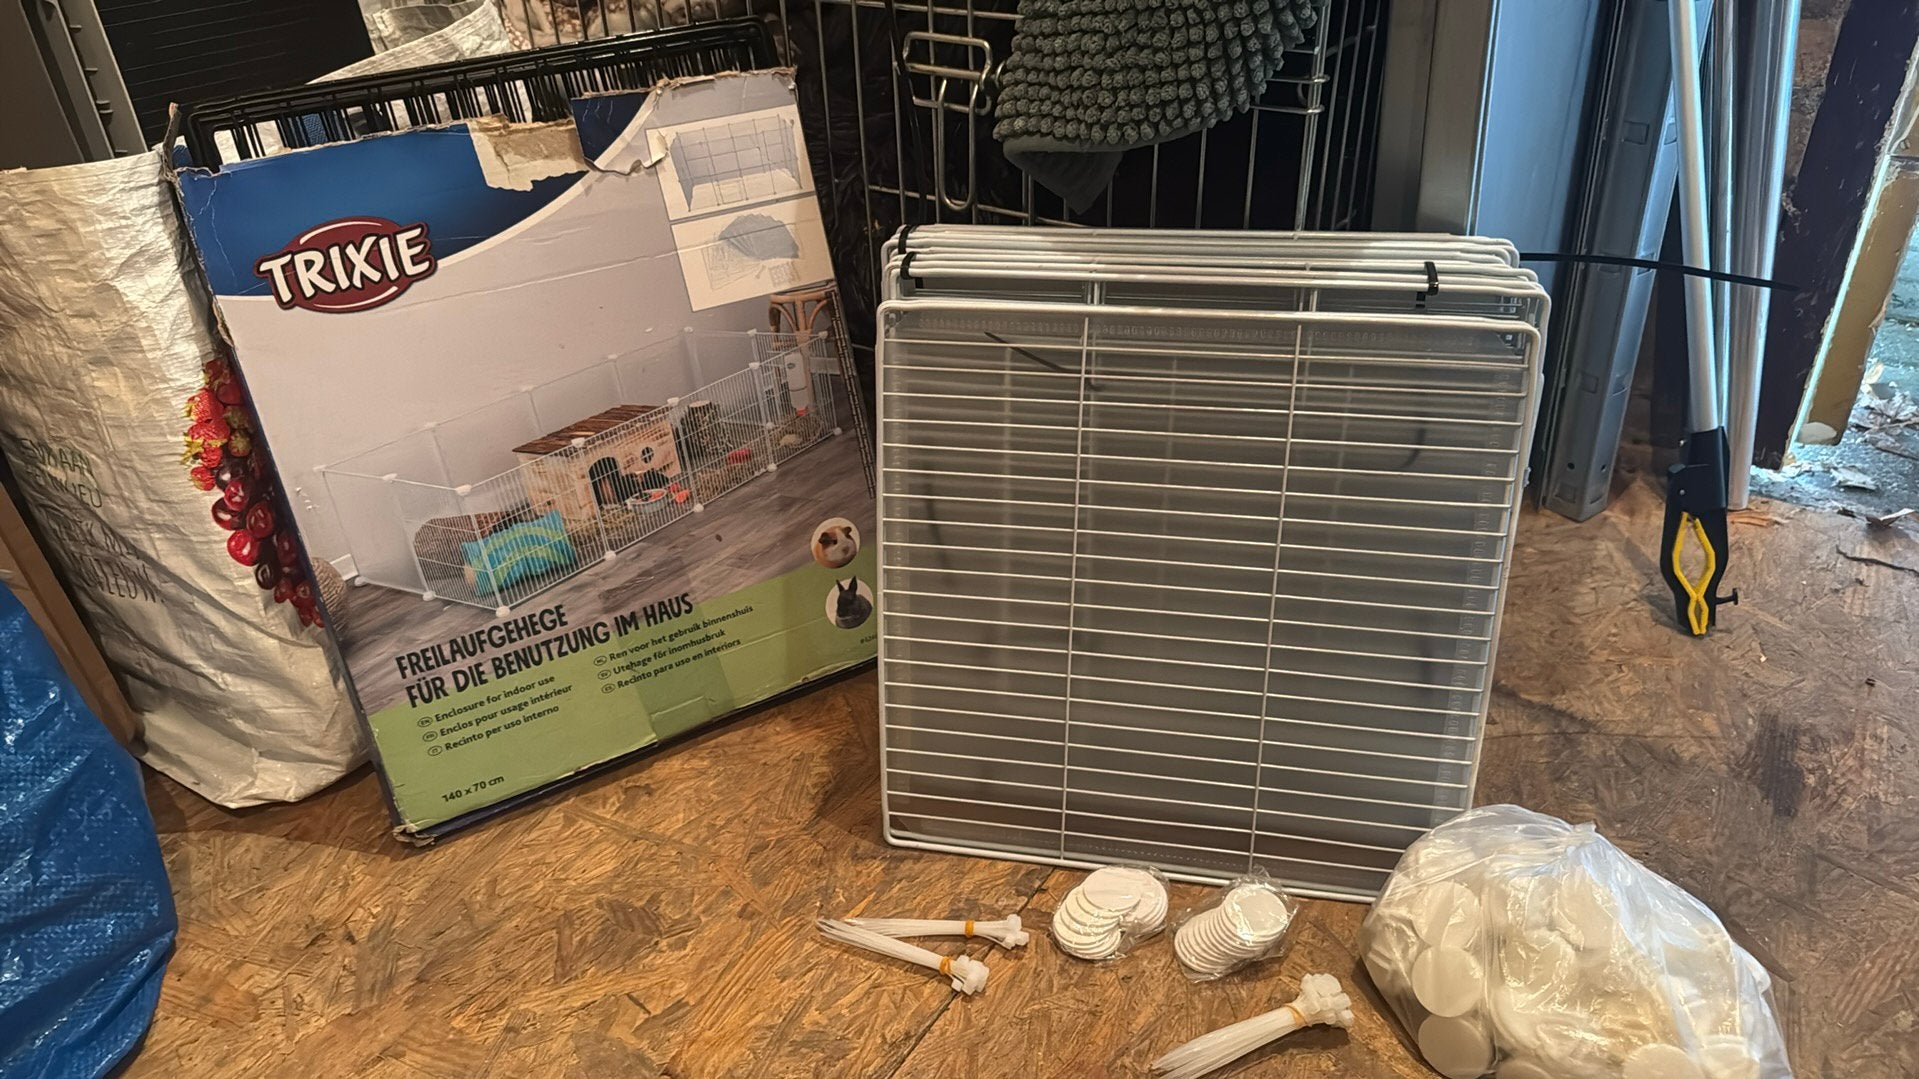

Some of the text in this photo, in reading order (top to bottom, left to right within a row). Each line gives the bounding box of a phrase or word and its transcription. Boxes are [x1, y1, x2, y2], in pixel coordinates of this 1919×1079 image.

[258, 226, 432, 304] TRIXIE
[395, 604, 568, 679] FREILAUFGEHEGE
[405, 592, 694, 708] FÜR DIE BENUTZUNG IM HAUS
[609, 649, 628, 661] Ren
[628, 642, 650, 654] voor
[651, 635, 667, 647] het
[668, 623, 701, 643] gebruik
[702, 605, 753, 628] binnenshuis
[613, 656, 652, 675] Utehage
[653, 649, 667, 661] för
[668, 629, 726, 654] inomhusbruk
[617, 669, 652, 688] Recinto
[653, 663, 674, 677] para
[675, 657, 691, 667] uso
[692, 652, 703, 662] en
[704, 638, 742, 656] interiors
[435, 700, 485, 722] Enclosure
[487, 693, 502, 705] for
[503, 682, 536, 699] indoor
[537, 675, 555, 686] use
[440, 720, 473, 737] Enclos
[475, 711, 499, 726] pour
[500, 700, 530, 716] usage
[531, 684, 573, 705] intérieur
[445, 732, 484, 751] Recinto
[485, 726, 502, 739] per
[504, 719, 522, 730] uso
[523, 705, 560, 723] interno
[442, 776, 505, 802] 140 x 70 cm
